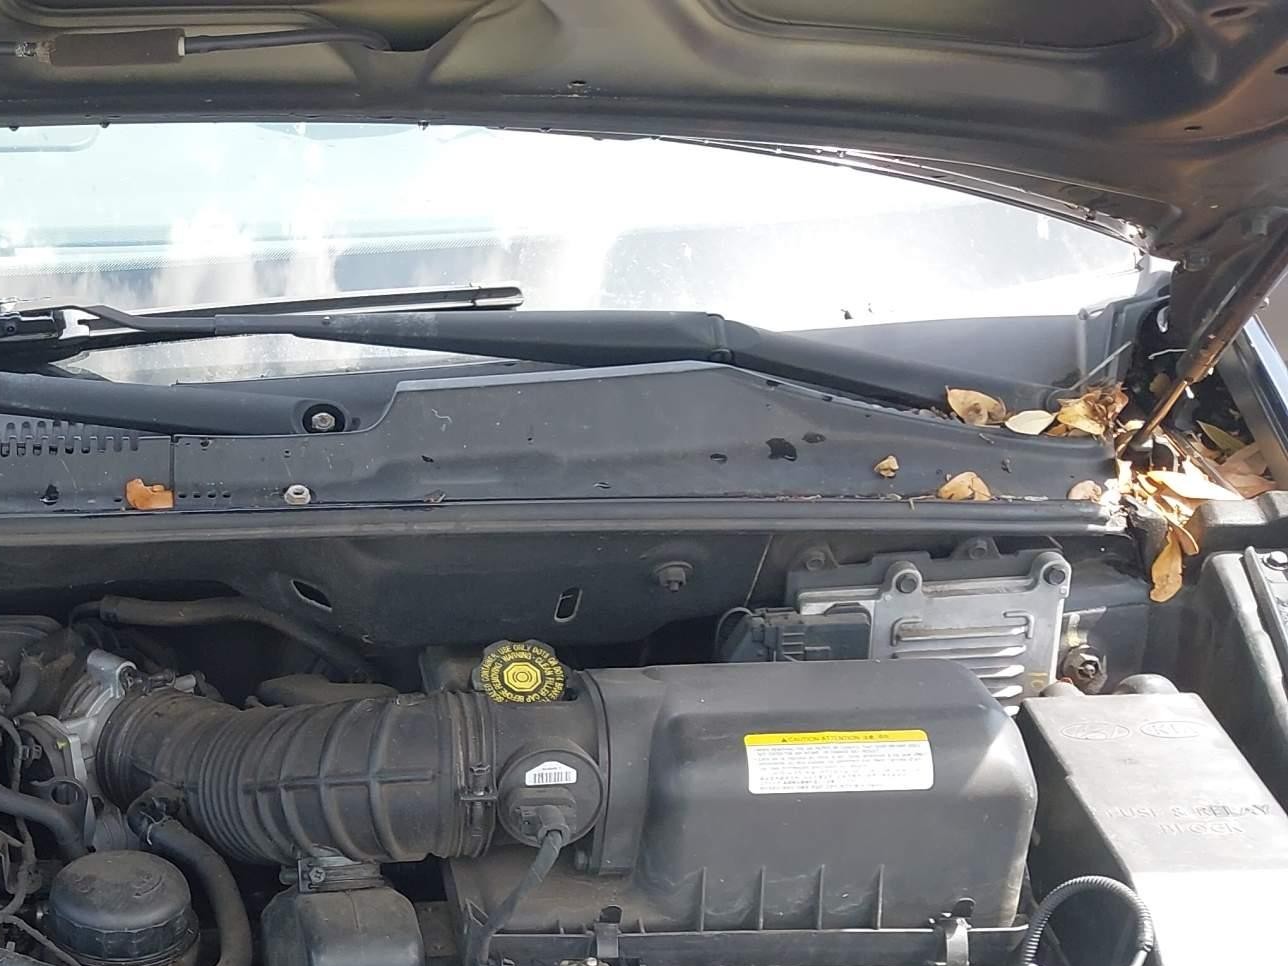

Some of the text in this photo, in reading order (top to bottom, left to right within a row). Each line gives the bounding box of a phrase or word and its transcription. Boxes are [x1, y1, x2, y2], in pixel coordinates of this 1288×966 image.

[513, 644, 532, 652] ONLY
[502, 651, 532, 662] WARNING
[535, 657, 553, 676] CLEAN
[539, 676, 555, 697] FILLER
[501, 687, 525, 703] BEFORE
[525, 692, 541, 703] CAP
[1192, 804, 1271, 817] RELAY
